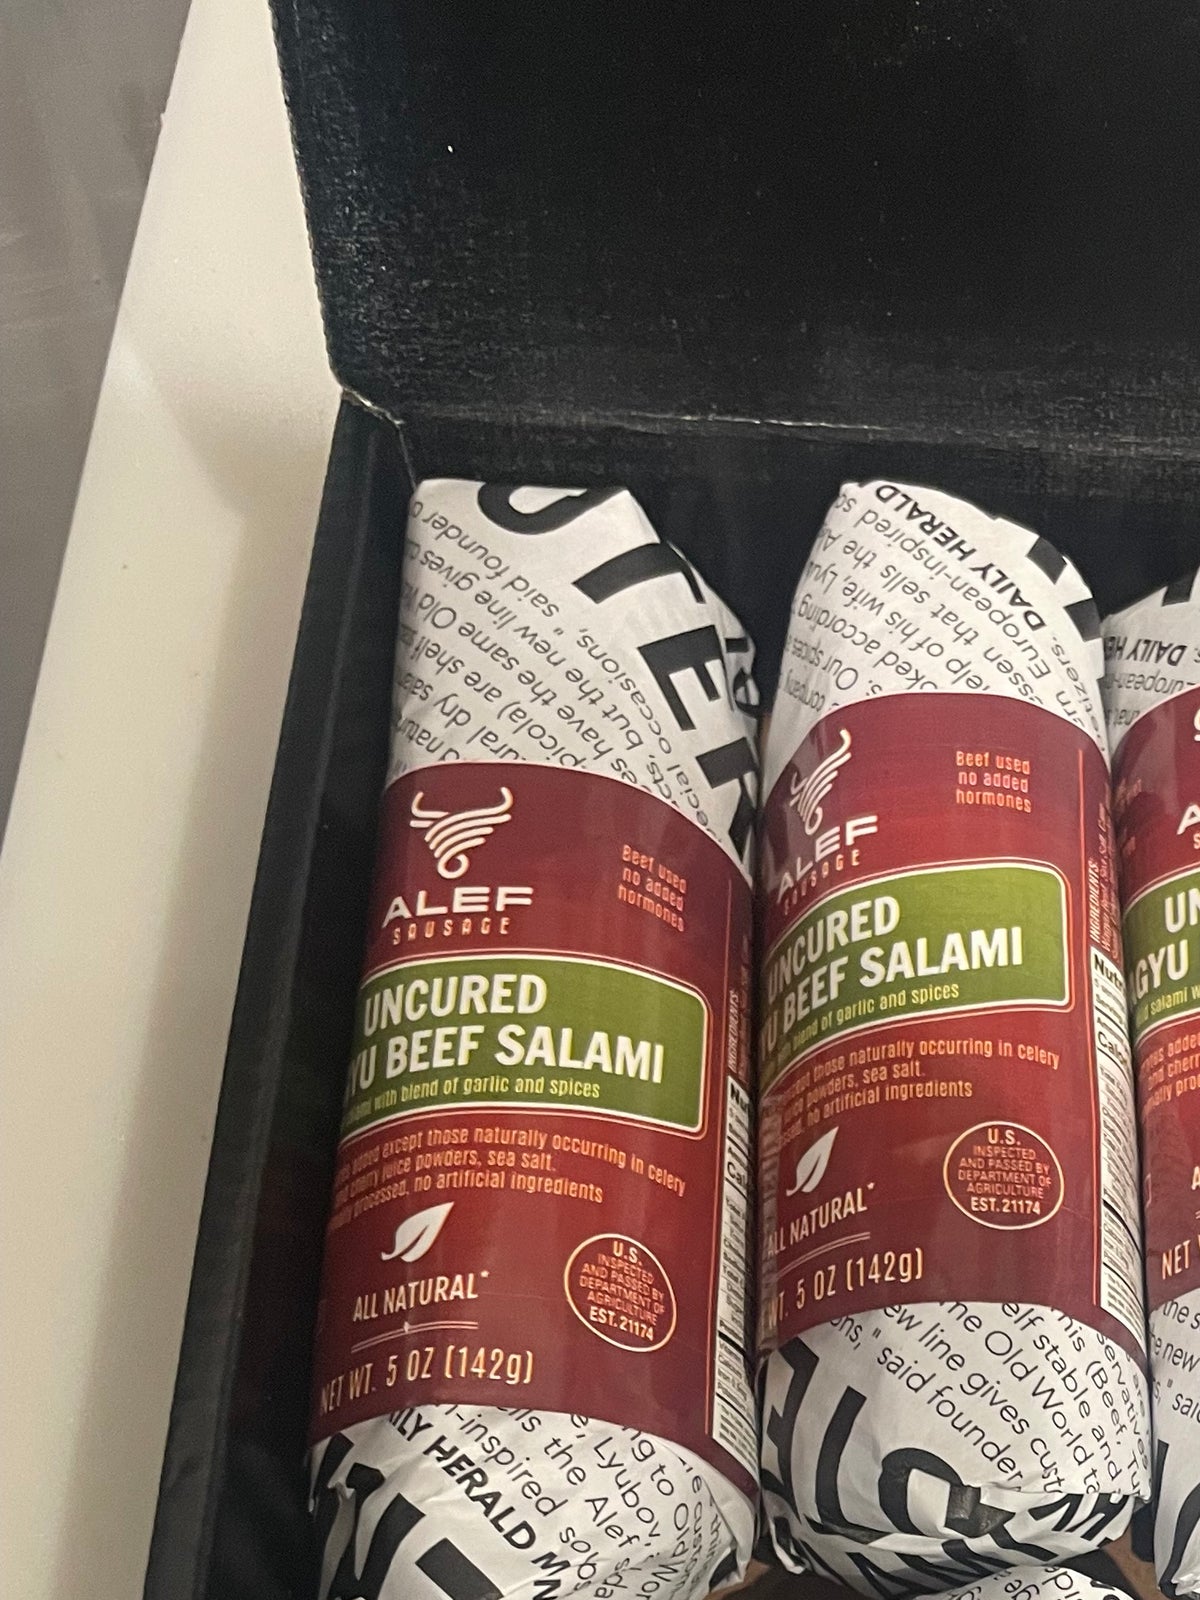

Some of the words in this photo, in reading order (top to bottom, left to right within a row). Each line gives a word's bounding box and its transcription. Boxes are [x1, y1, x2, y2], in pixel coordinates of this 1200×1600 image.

[875, 484, 975, 561] HERALD
[422, 510, 511, 581] founder
[843, 539, 877, 570] the
[508, 574, 560, 619] said
[880, 564, 930, 603] sells
[970, 561, 1047, 632] DAILY
[798, 592, 881, 655] according
[929, 605, 980, 647] that
[458, 626, 520, 677] same
[956, 751, 989, 768] Beef
[996, 754, 1031, 774] used
[958, 769, 978, 786] no
[983, 772, 1028, 792] added
[956, 789, 1032, 812] hormones
[382, 886, 534, 929] ALEF
[859, 926, 1023, 988] SALAMI
[364, 974, 547, 1037] UNCURED
[386, 1026, 485, 1079] BEEF
[494, 1026, 664, 1084] SALAMI
[463, 1077, 509, 1098] garlic
[515, 1078, 544, 1095] and
[549, 1080, 600, 1100] spices
[473, 1128, 547, 1150] naturally
[552, 1134, 626, 1168] occurring
[988, 1129, 1021, 1143] U.S.
[971, 1198, 1000, 1212] EST.
[1003, 1198, 1040, 1215] 21174
[1161, 1240, 1192, 1280] NET
[386, 1356, 398, 1383] 5
[407, 1347, 434, 1381] OZ
[1033, 1333, 1091, 1419] stable
[423, 1434, 536, 1550] HERALD
